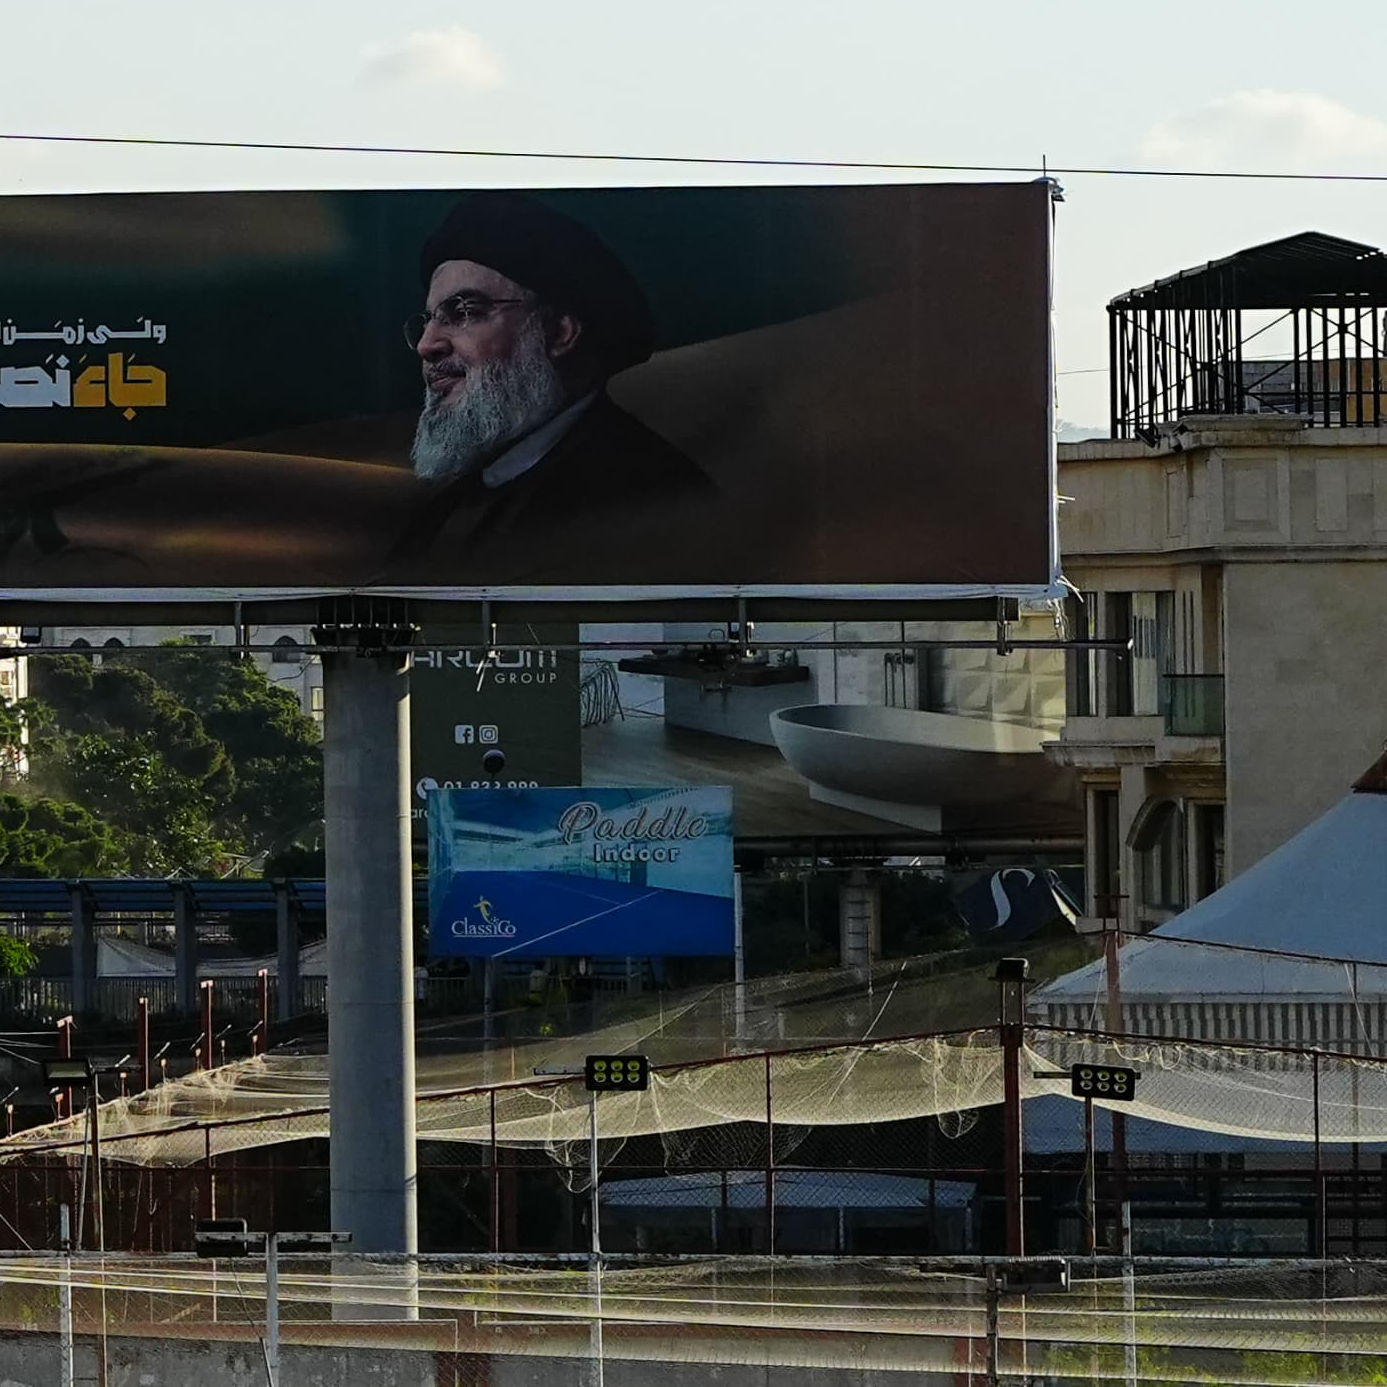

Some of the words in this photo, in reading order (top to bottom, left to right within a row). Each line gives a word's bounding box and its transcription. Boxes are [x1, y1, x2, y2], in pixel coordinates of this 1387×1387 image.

[494, 672, 557, 684] GROUP
[558, 801, 707, 845] Paddle
[593, 843, 681, 863] Indoor
